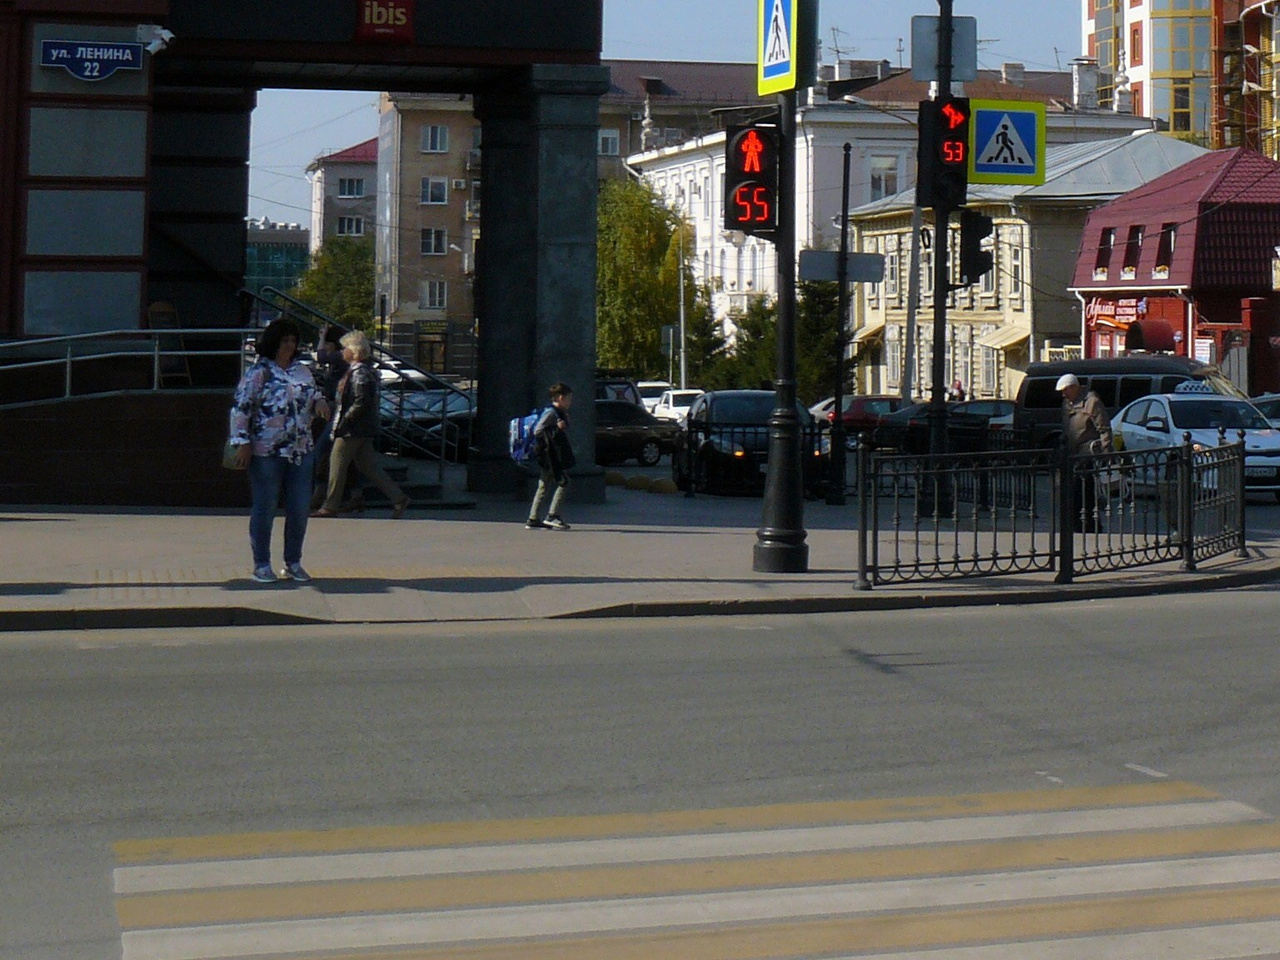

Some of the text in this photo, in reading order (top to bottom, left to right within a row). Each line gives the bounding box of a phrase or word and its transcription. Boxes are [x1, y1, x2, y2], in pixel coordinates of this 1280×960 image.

[364, 1, 407, 25] ibis
[51, 47, 133, 61] ул. ЛЕНИНА
[84, 61, 99, 76] 22
[943, 141, 963, 162] 53
[735, 187, 769, 221] 55
